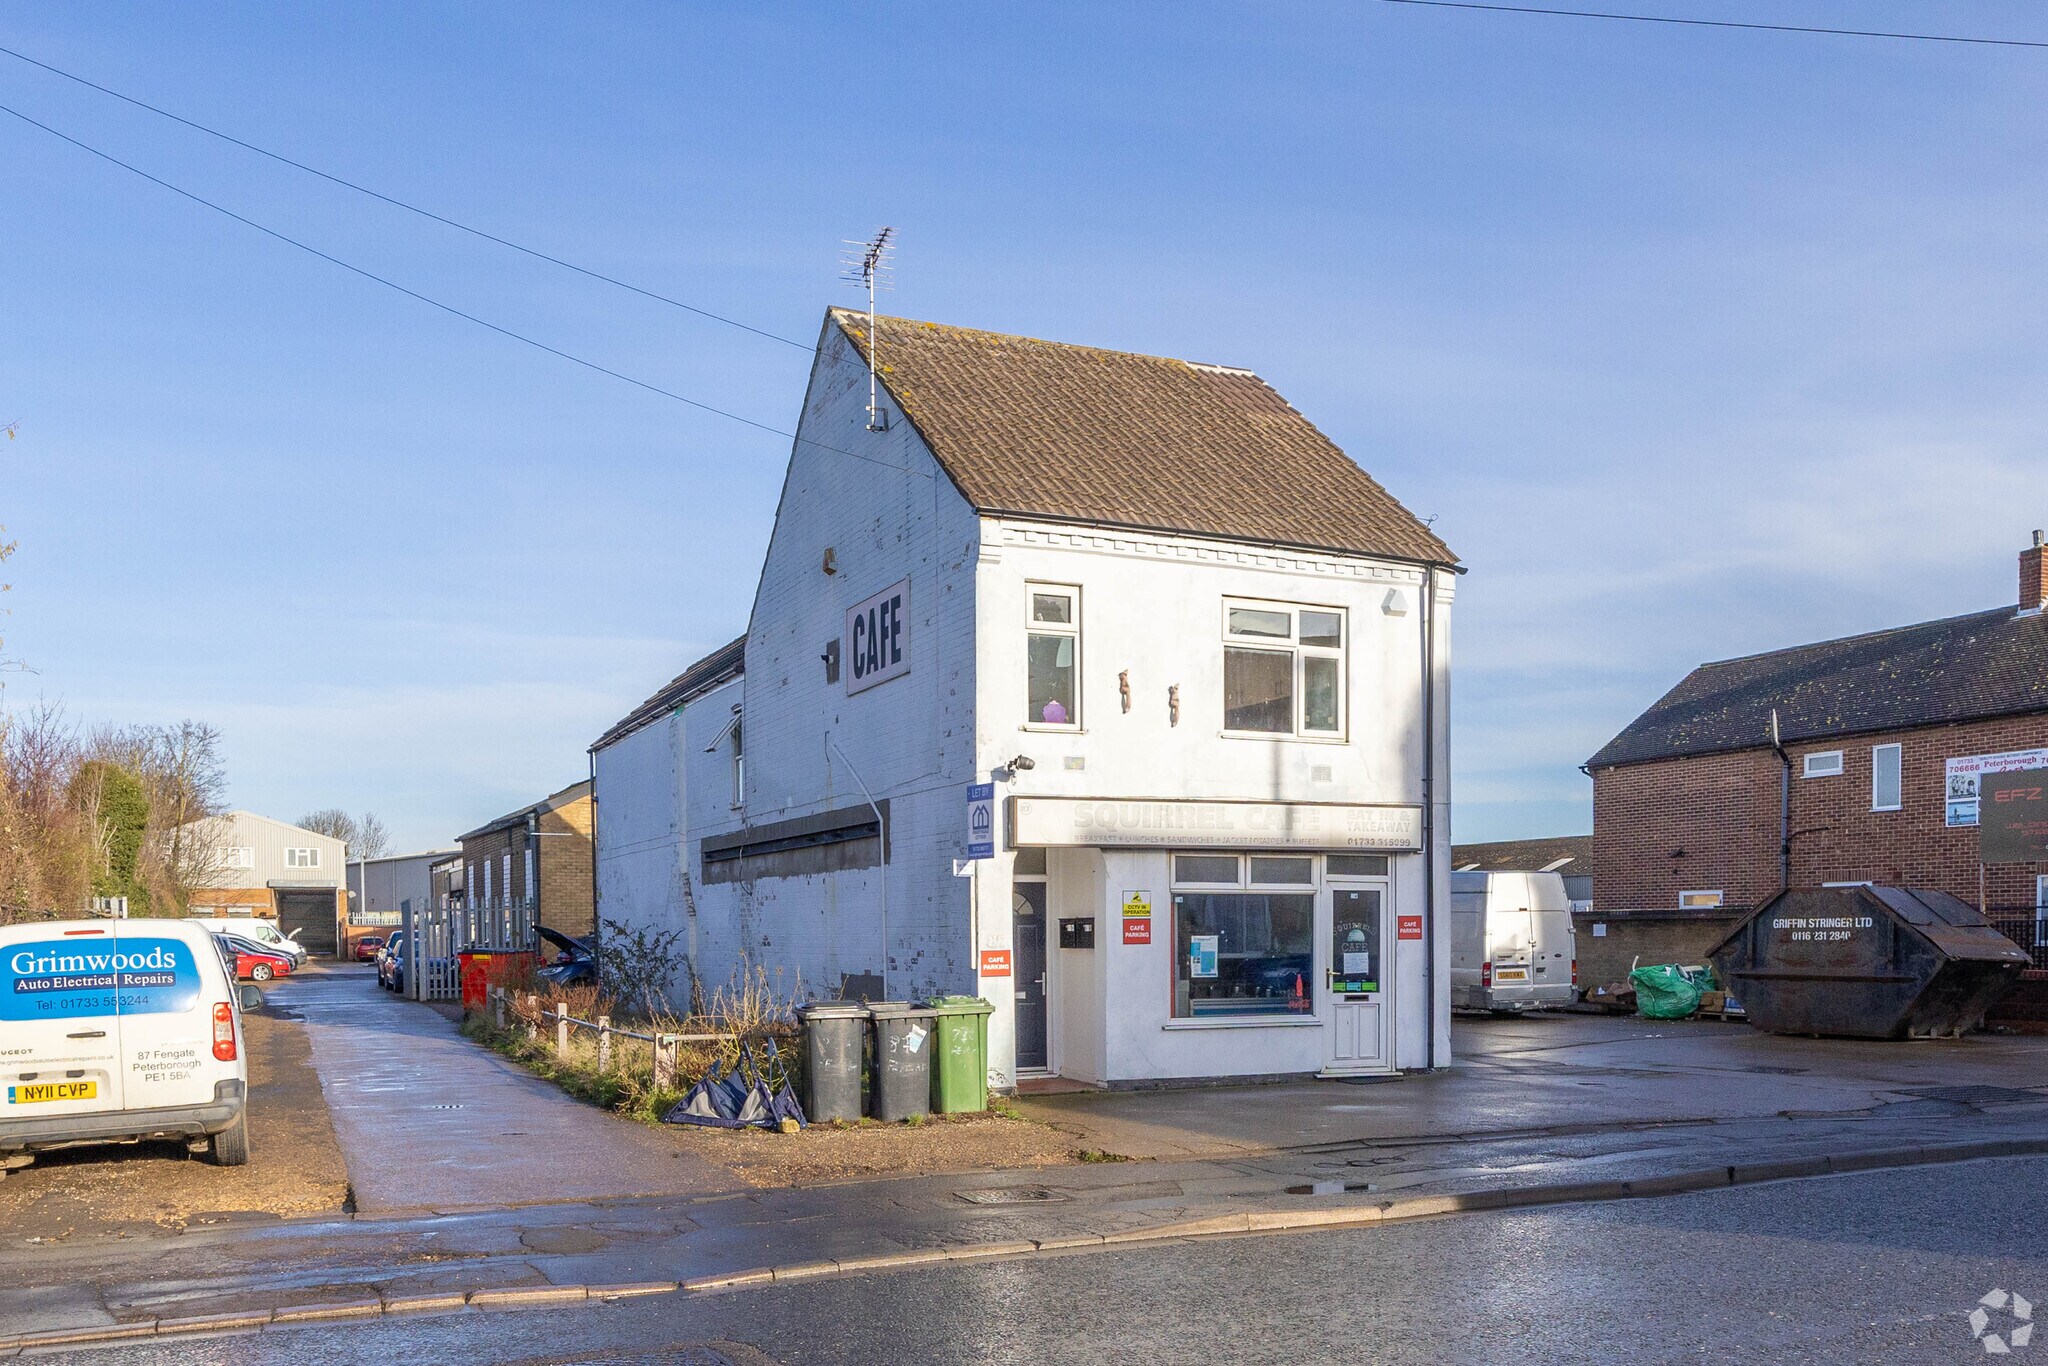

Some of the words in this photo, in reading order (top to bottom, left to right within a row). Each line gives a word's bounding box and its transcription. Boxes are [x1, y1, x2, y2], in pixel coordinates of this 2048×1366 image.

[853, 594, 901, 679] CAFE
[1984, 756, 2037, 768] Peterborough
[1949, 764, 1980, 773] 706666
[971, 787, 981, 798] LET
[982, 786, 990, 797] BY
[1074, 803, 1234, 832] SQUIRREL
[1245, 806, 1320, 831] CAFE
[1347, 809, 1373, 820] EAT
[1379, 809, 1394, 821] IN
[1399, 810, 1411, 821] &
[1346, 821, 1411, 833] TAKEAWAY
[1075, 834, 1118, 843] BREAKFAST
[1125, 835, 1159, 843] LUNCHES
[1167, 836, 1215, 844] SANDWICHES
[1222, 837, 1248, 845] JACKET
[1249, 837, 1284, 845] POTATOES
[1347, 837, 1376, 846] 01733
[1773, 918, 1806, 928] GRIFFIN
[1808, 918, 1853, 928] STRINGER
[1855, 917, 1873, 927] LTD
[1792, 931, 1811, 940] 0116
[1812, 931, 1827, 940] 231
[1829, 931, 1851, 940] 2840
[1341, 942, 1368, 952] CAFE
[11, 947, 176, 974] Grimwoods
[17, 979, 51, 991] Auto
[53, 974, 118, 988] Electrical
[124, 973, 174, 985] Repairs
[36, 1001, 57, 1011] Tel:
[60, 997, 99, 1009] 01733
[103, 995, 149, 1007] 553244
[137, 1051, 150, 1060] 87
[154, 1049, 195, 1059] Fengate
[133, 1059, 201, 1071] Peterborough
[145, 1072, 166, 1082] PE1
[169, 1071, 191, 1080] 5BA
[25, 1085, 53, 1100] NY11
[58, 1083, 88, 1097] CVP
